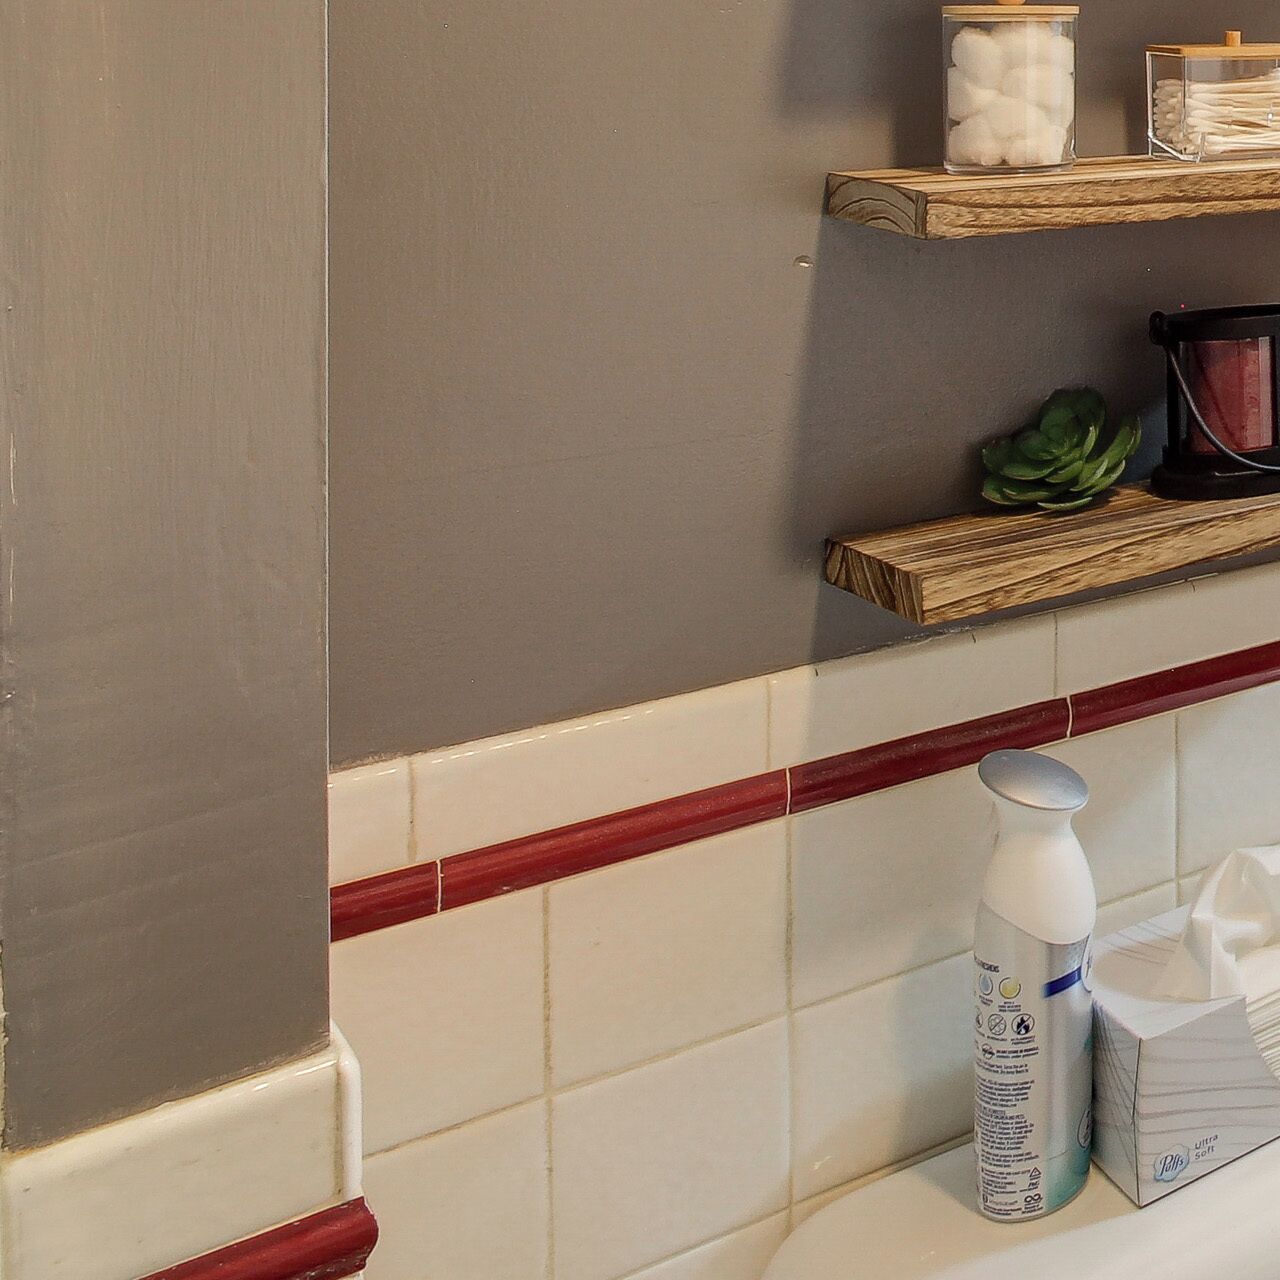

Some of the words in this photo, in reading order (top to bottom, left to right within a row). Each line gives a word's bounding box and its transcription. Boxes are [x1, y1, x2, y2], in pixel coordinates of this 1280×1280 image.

[1194, 1134, 1219, 1150] Ultra
[1194, 1145, 1215, 1160] Soft
[1160, 1154, 1184, 1177] Puffs
